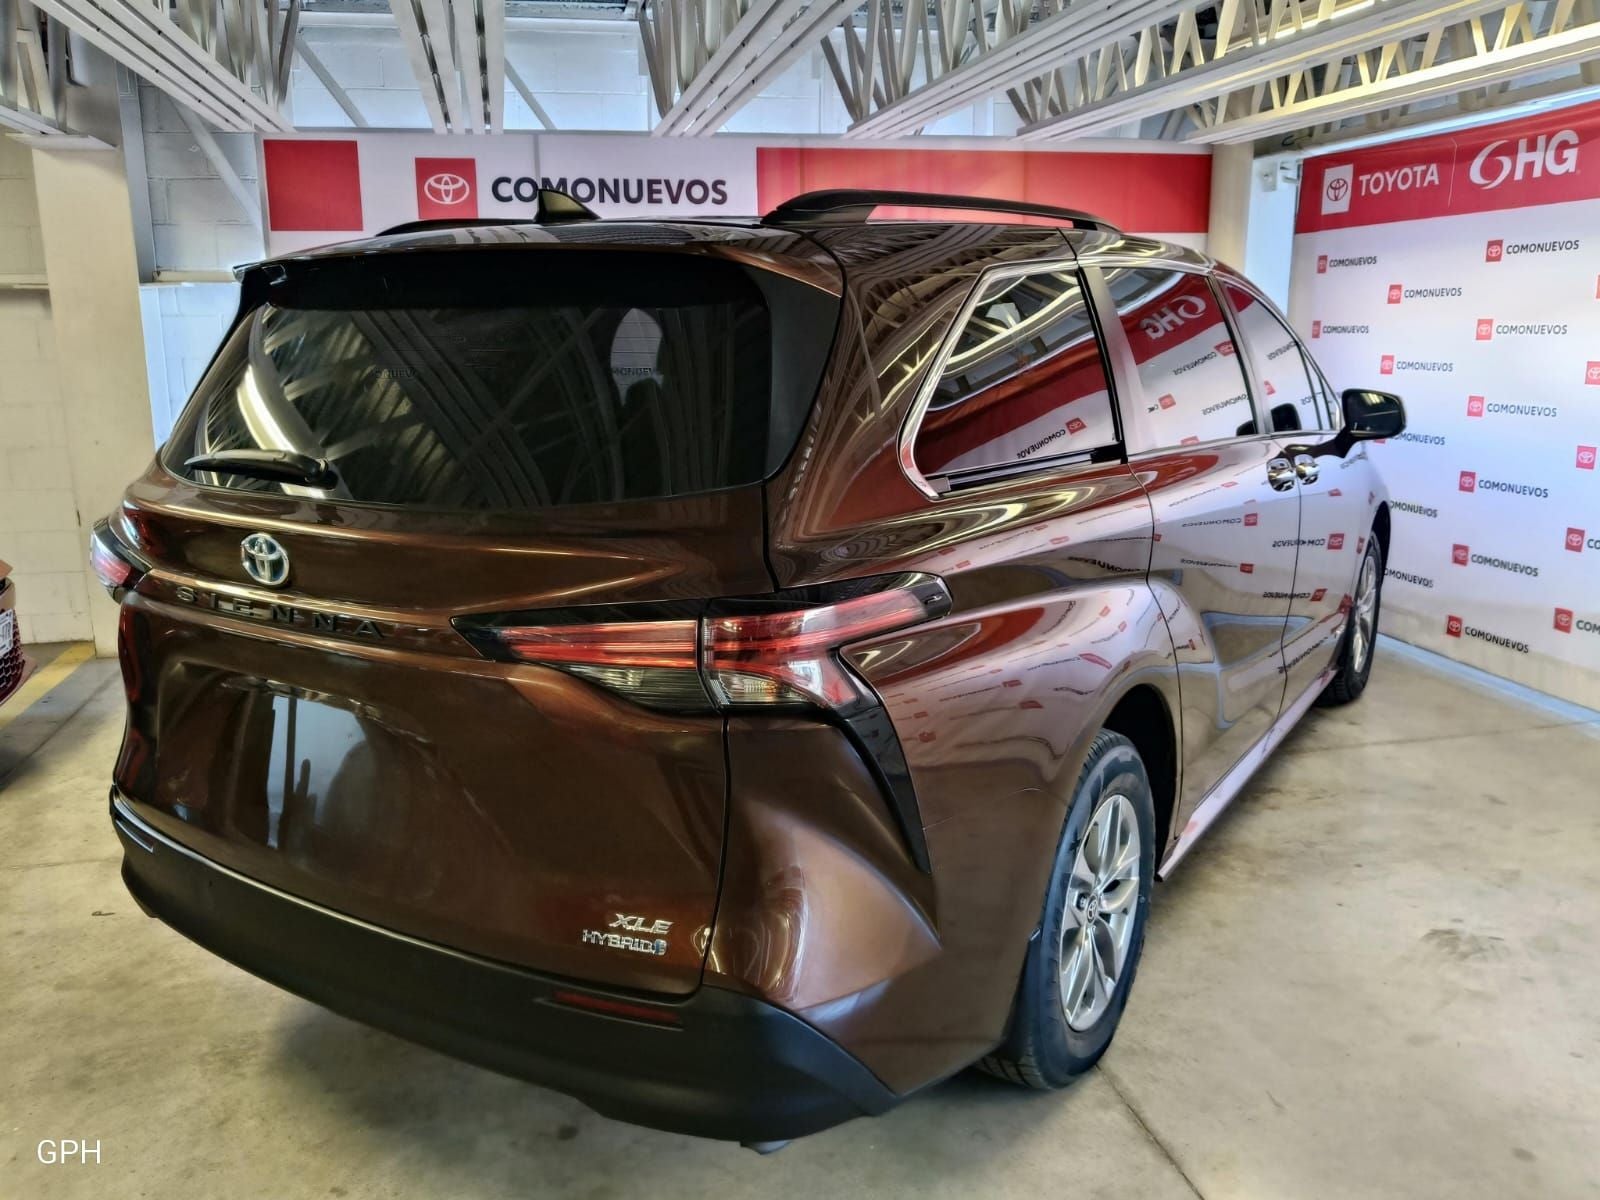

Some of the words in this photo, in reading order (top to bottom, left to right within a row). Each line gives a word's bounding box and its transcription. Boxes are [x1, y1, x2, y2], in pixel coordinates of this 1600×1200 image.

[1359, 163, 1440, 197] TOYOTA
[491, 176, 728, 205] COMONUEVOS
[1506, 239, 1580, 255] COMONUEVOS
[1329, 255, 1378, 268] COMONUEVOS
[1404, 287, 1462, 299] COMONUEVOS
[1322, 325, 1370, 335] COMONUEVOS
[1495, 323, 1568, 336] COMONUEVOS
[1396, 361, 1454, 373] COMONUEVOS
[1486, 402, 1558, 418] COMONUEVOS
[1394, 431, 1446, 446] MONUEVOS
[1478, 479, 1549, 498] COMONUEVOS
[1390, 500, 1438, 518] OMONUEVOS
[1470, 553, 1539, 577] COMONUEVOS
[1384, 567, 1434, 588] OMONUEVOS
[175, 585, 385, 640] SIENNA
[1464, 626, 1529, 654] COMONUEVOS
[608, 913, 674, 935] XLE
[582, 929, 656, 955] HYBRID
